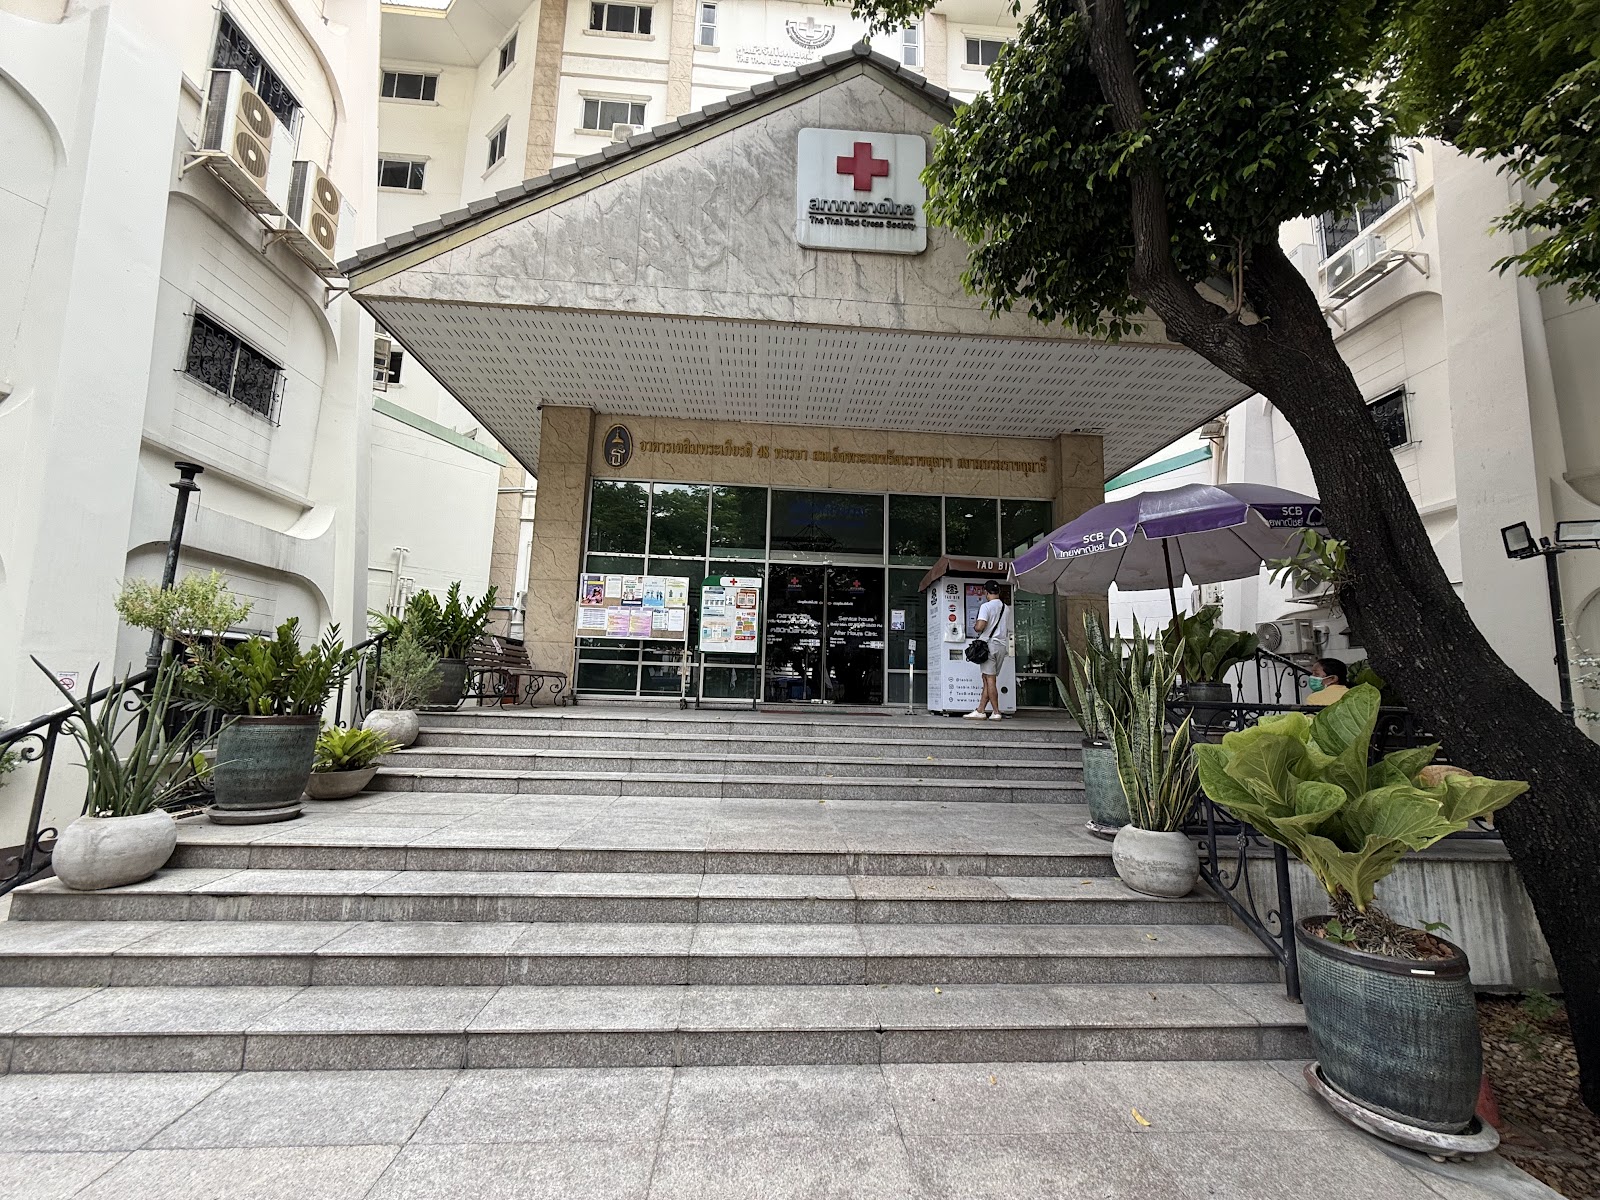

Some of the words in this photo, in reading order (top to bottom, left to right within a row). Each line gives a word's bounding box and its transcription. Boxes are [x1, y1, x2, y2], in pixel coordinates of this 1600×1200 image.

[768, 58, 781, 66] RED
[809, 197, 916, 216] สภากาชาดไทย
[809, 215, 824, 225] The
[825, 216, 843, 226] Thai
[844, 217, 859, 227] Red
[861, 219, 884, 229] Cross
[886, 220, 916, 231] Society
[756, 445, 769, 459] 48
[1281, 506, 1303, 516] SCB
[1269, 517, 1304, 527] ยพาณิชย์
[1082, 532, 1105, 544] SCB
[1060, 542, 1105, 557] ไทยพาณิชย์
[976, 560, 994, 570] TAO
[998, 561, 1011, 571] BI
